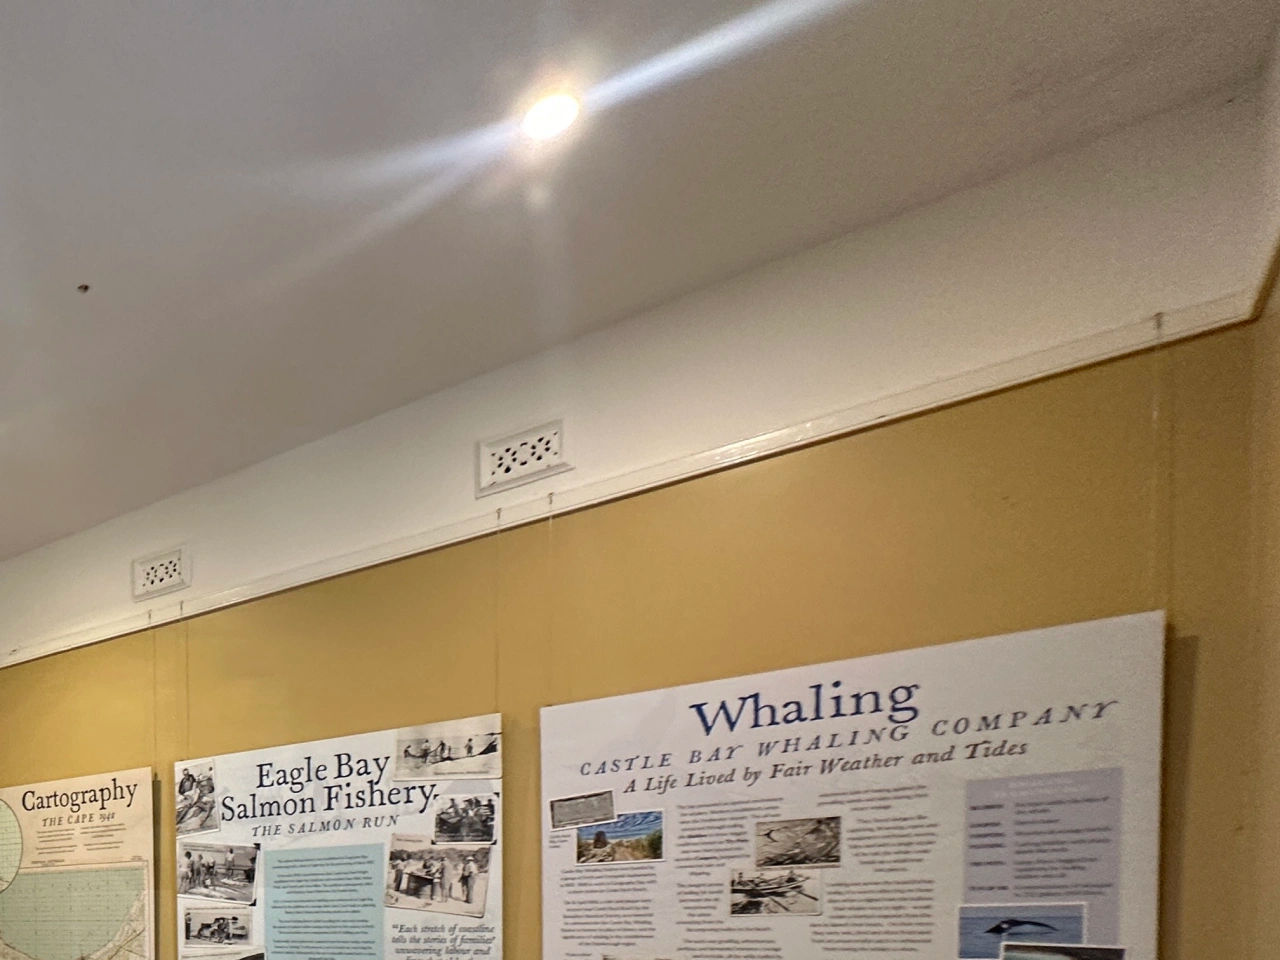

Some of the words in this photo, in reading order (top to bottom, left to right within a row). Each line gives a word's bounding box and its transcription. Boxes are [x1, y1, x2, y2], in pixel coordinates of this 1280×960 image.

[688, 680, 920, 736] Whaling
[580, 752, 673, 776] CASTLE
[688, 744, 744, 764] BAY
[756, 724, 912, 758] WHALING
[931, 700, 1120, 737] COMPANY
[256, 756, 328, 793] Eagle
[334, 752, 391, 785] Bay
[622, 778, 638, 794] A
[645, 774, 677, 795] Life
[685, 769, 736, 787] Lived
[743, 768, 762, 787] by
[769, 760, 813, 779] Fair
[819, 753, 904, 775] Weather
[911, 745, 955, 766] and
[965, 738, 1028, 760] Tides
[22, 777, 138, 813] Cartography
[221, 794, 316, 823] Salmon
[323, 779, 438, 814] Fishery
[42, 816, 63, 827] THE
[67, 813, 95, 824] CAPE
[252, 823, 281, 837] THE
[288, 818, 356, 834] SALMON
[362, 814, 401, 830] RUN
[448, 923, 458, 936] of
[473, 946, 492, 955] and
